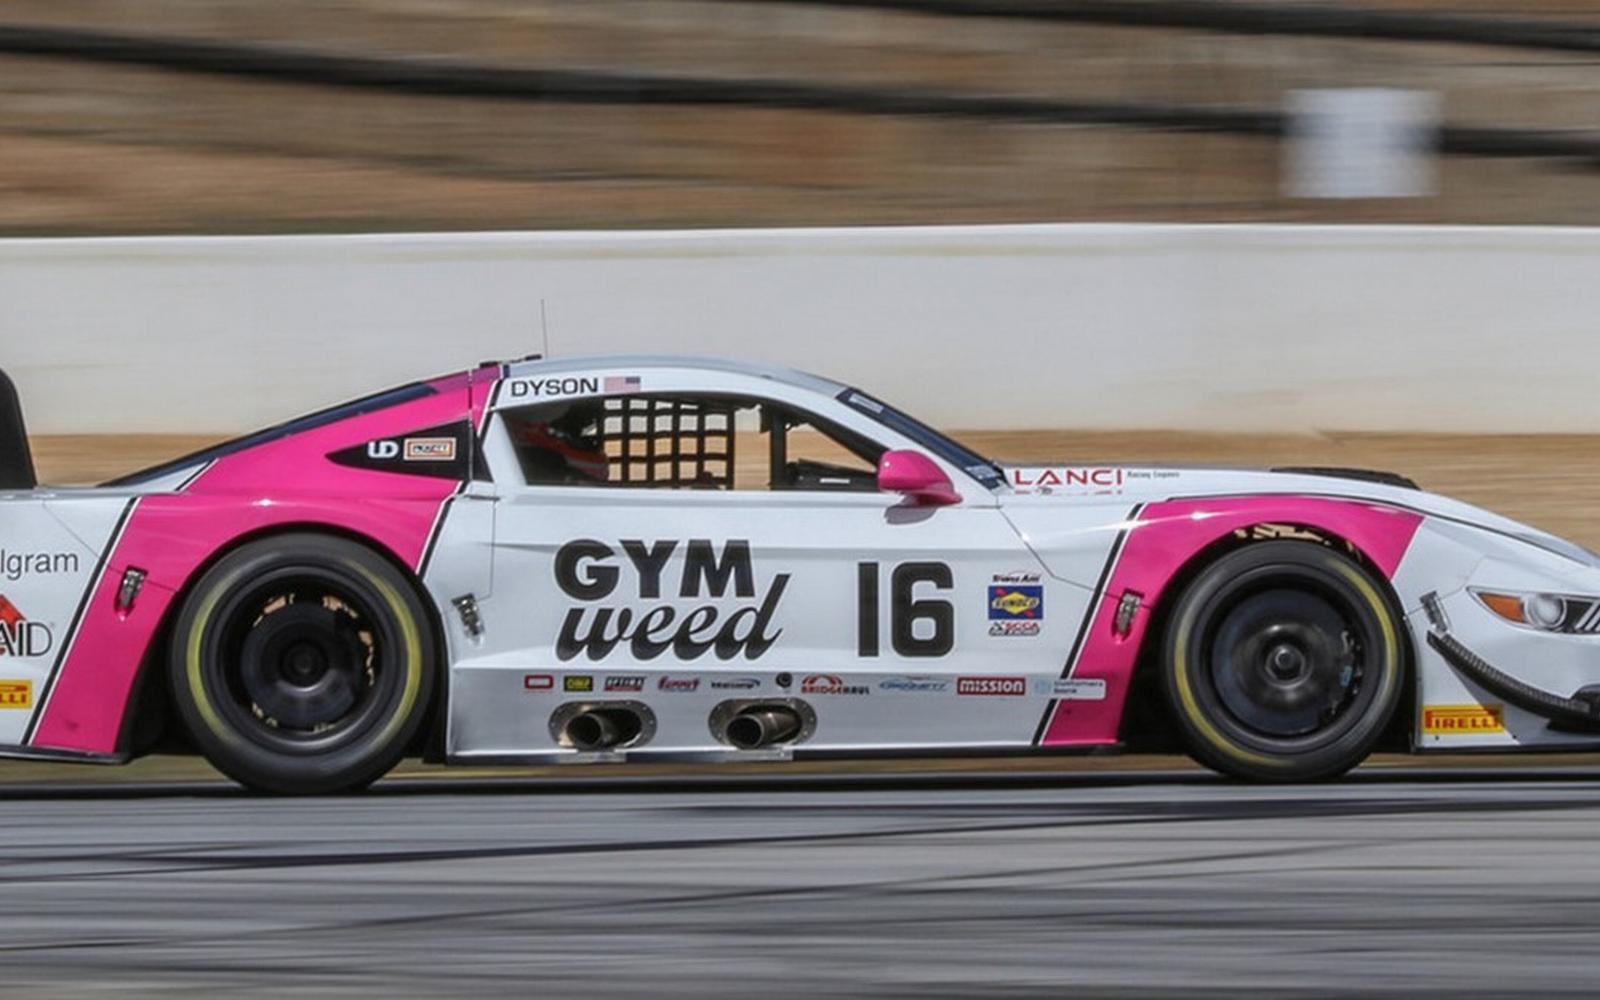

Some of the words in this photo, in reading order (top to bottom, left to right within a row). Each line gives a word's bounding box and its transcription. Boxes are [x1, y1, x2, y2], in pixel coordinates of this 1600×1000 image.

[511, 377, 598, 397] DYSON
[1014, 469, 1122, 486] LANCI
[553, 538, 755, 600] GYM
[555, 573, 791, 661] weed
[857, 561, 954, 657] 16
[958, 678, 1024, 693] mission
